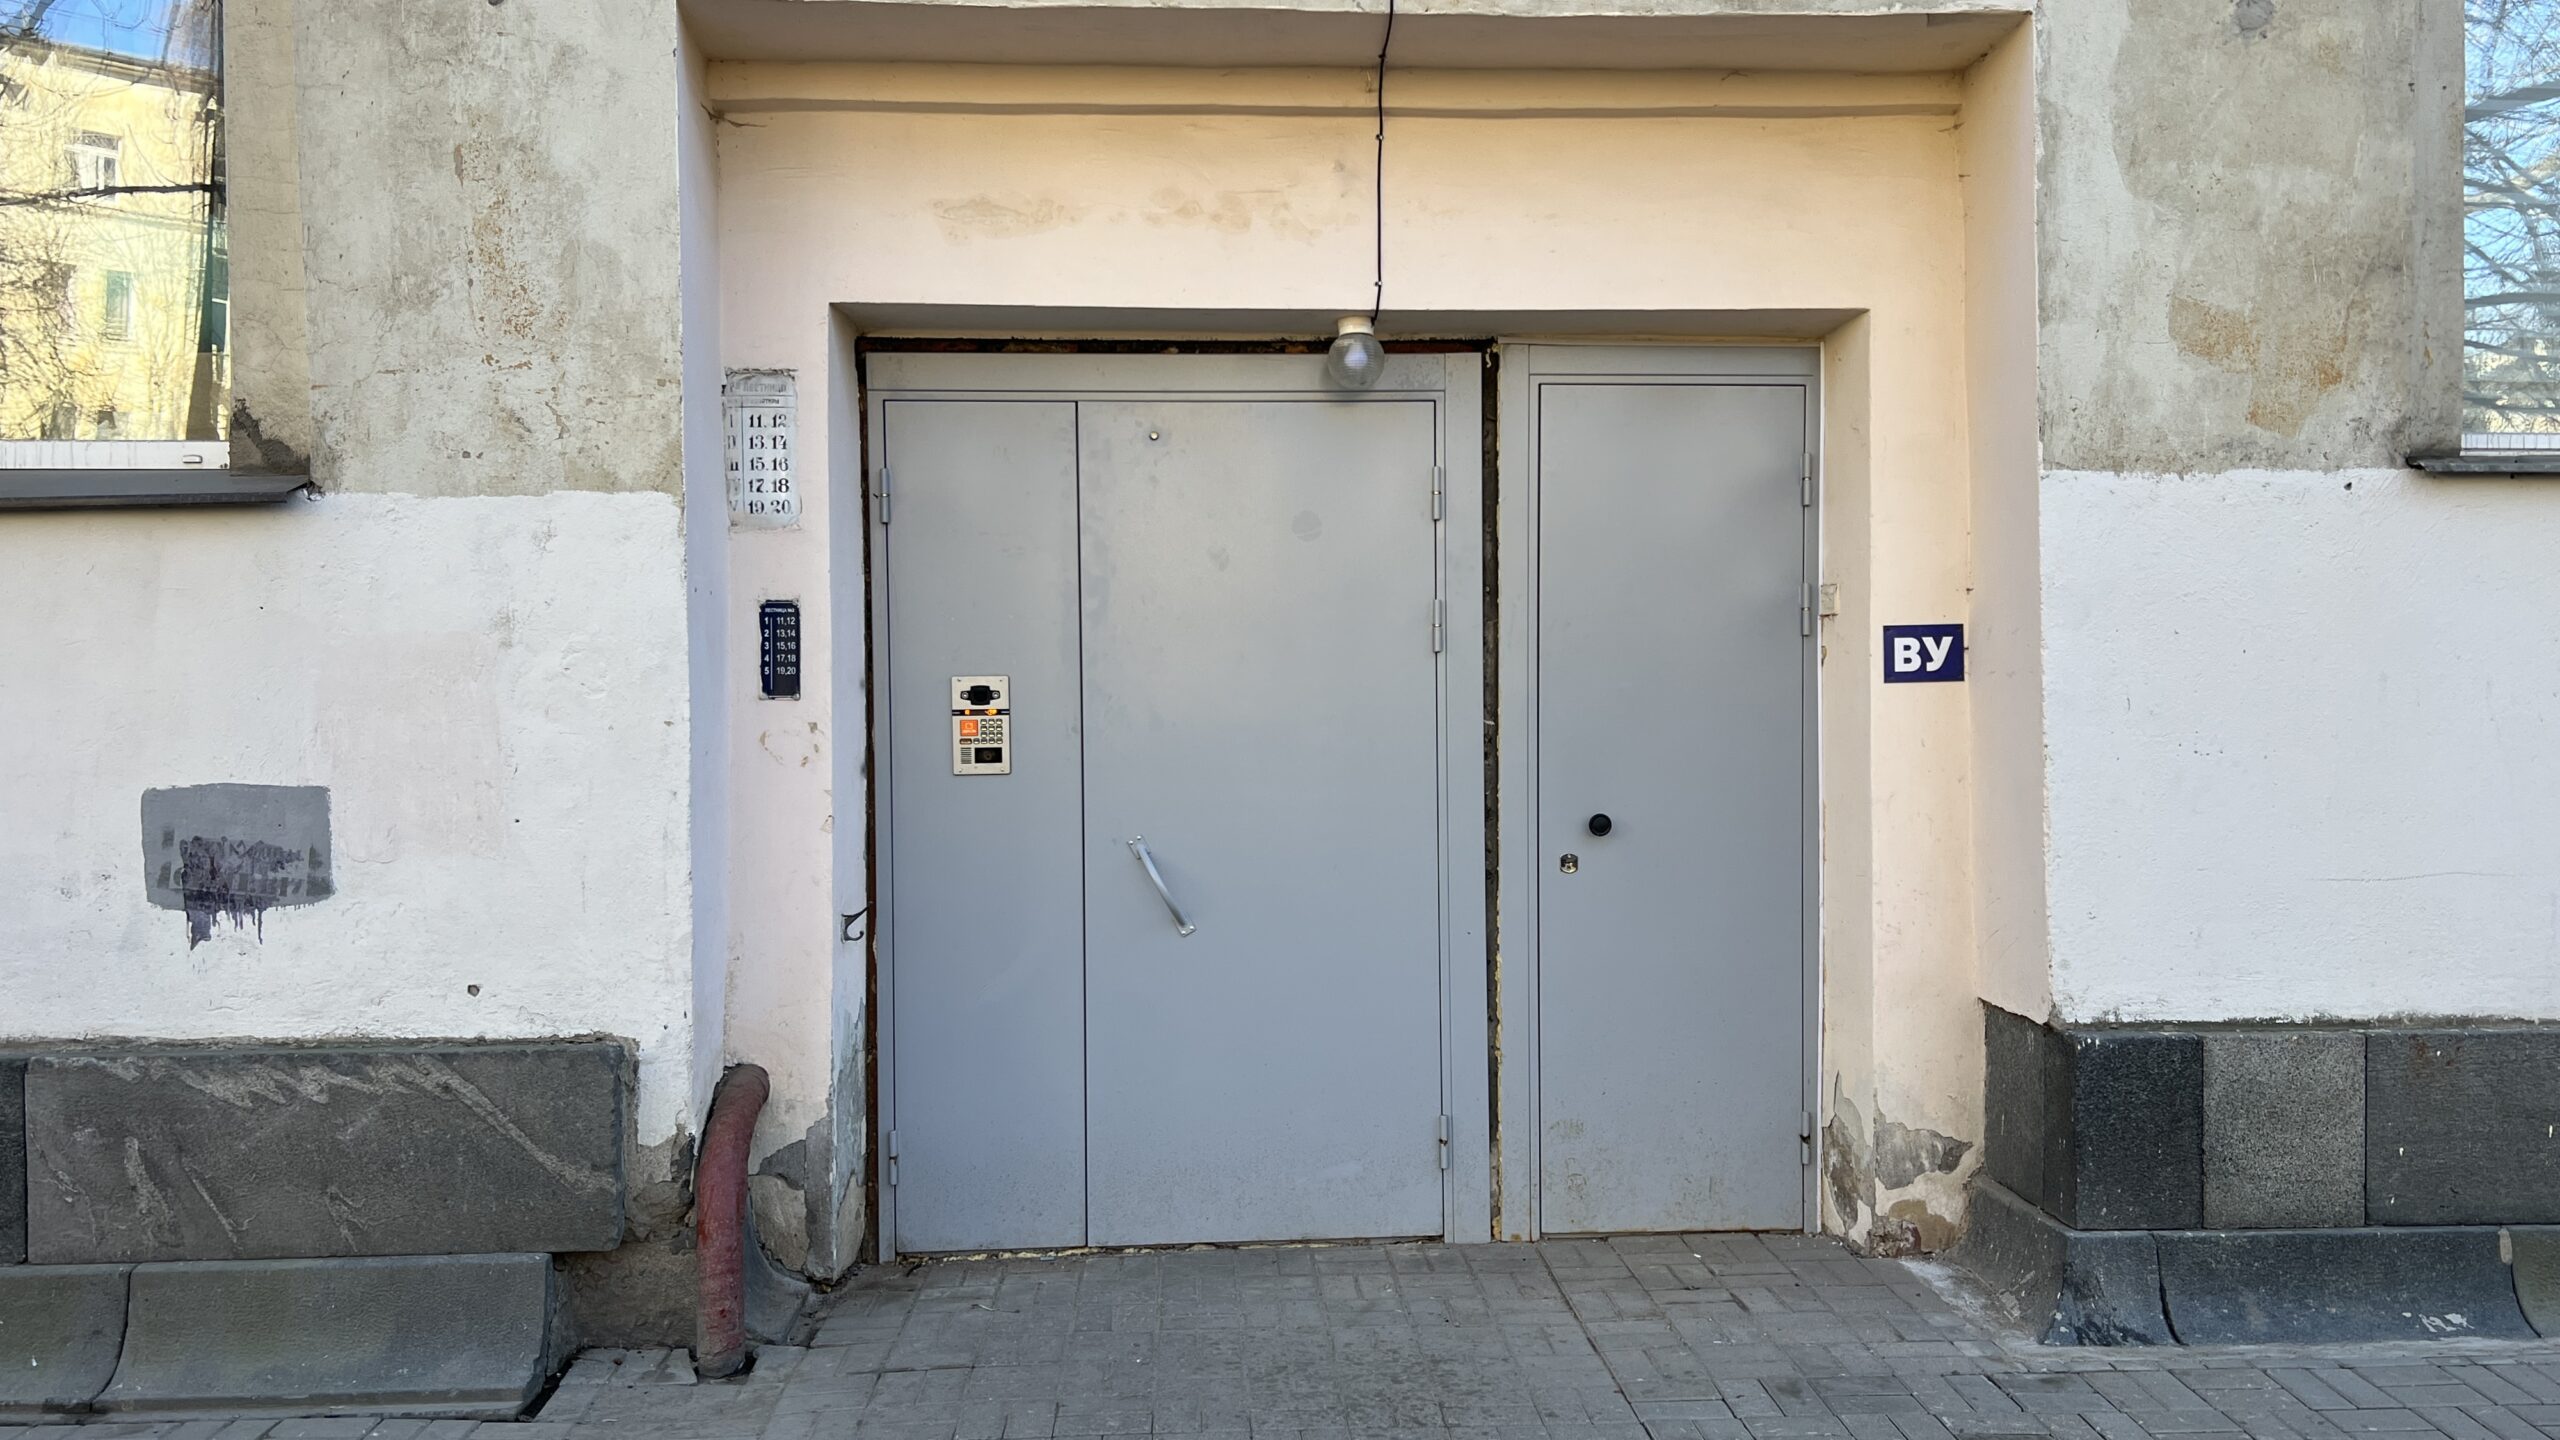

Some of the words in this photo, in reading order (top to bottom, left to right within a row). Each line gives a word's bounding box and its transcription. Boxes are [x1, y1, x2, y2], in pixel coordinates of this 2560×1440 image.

[764, 617, 769, 625] 1
[764, 629, 769, 638] 2
[764, 642, 769, 650] 3
[1894, 636, 1953, 672] ВУ
[764, 654, 769, 663] 4
[764, 667, 769, 675] 5
